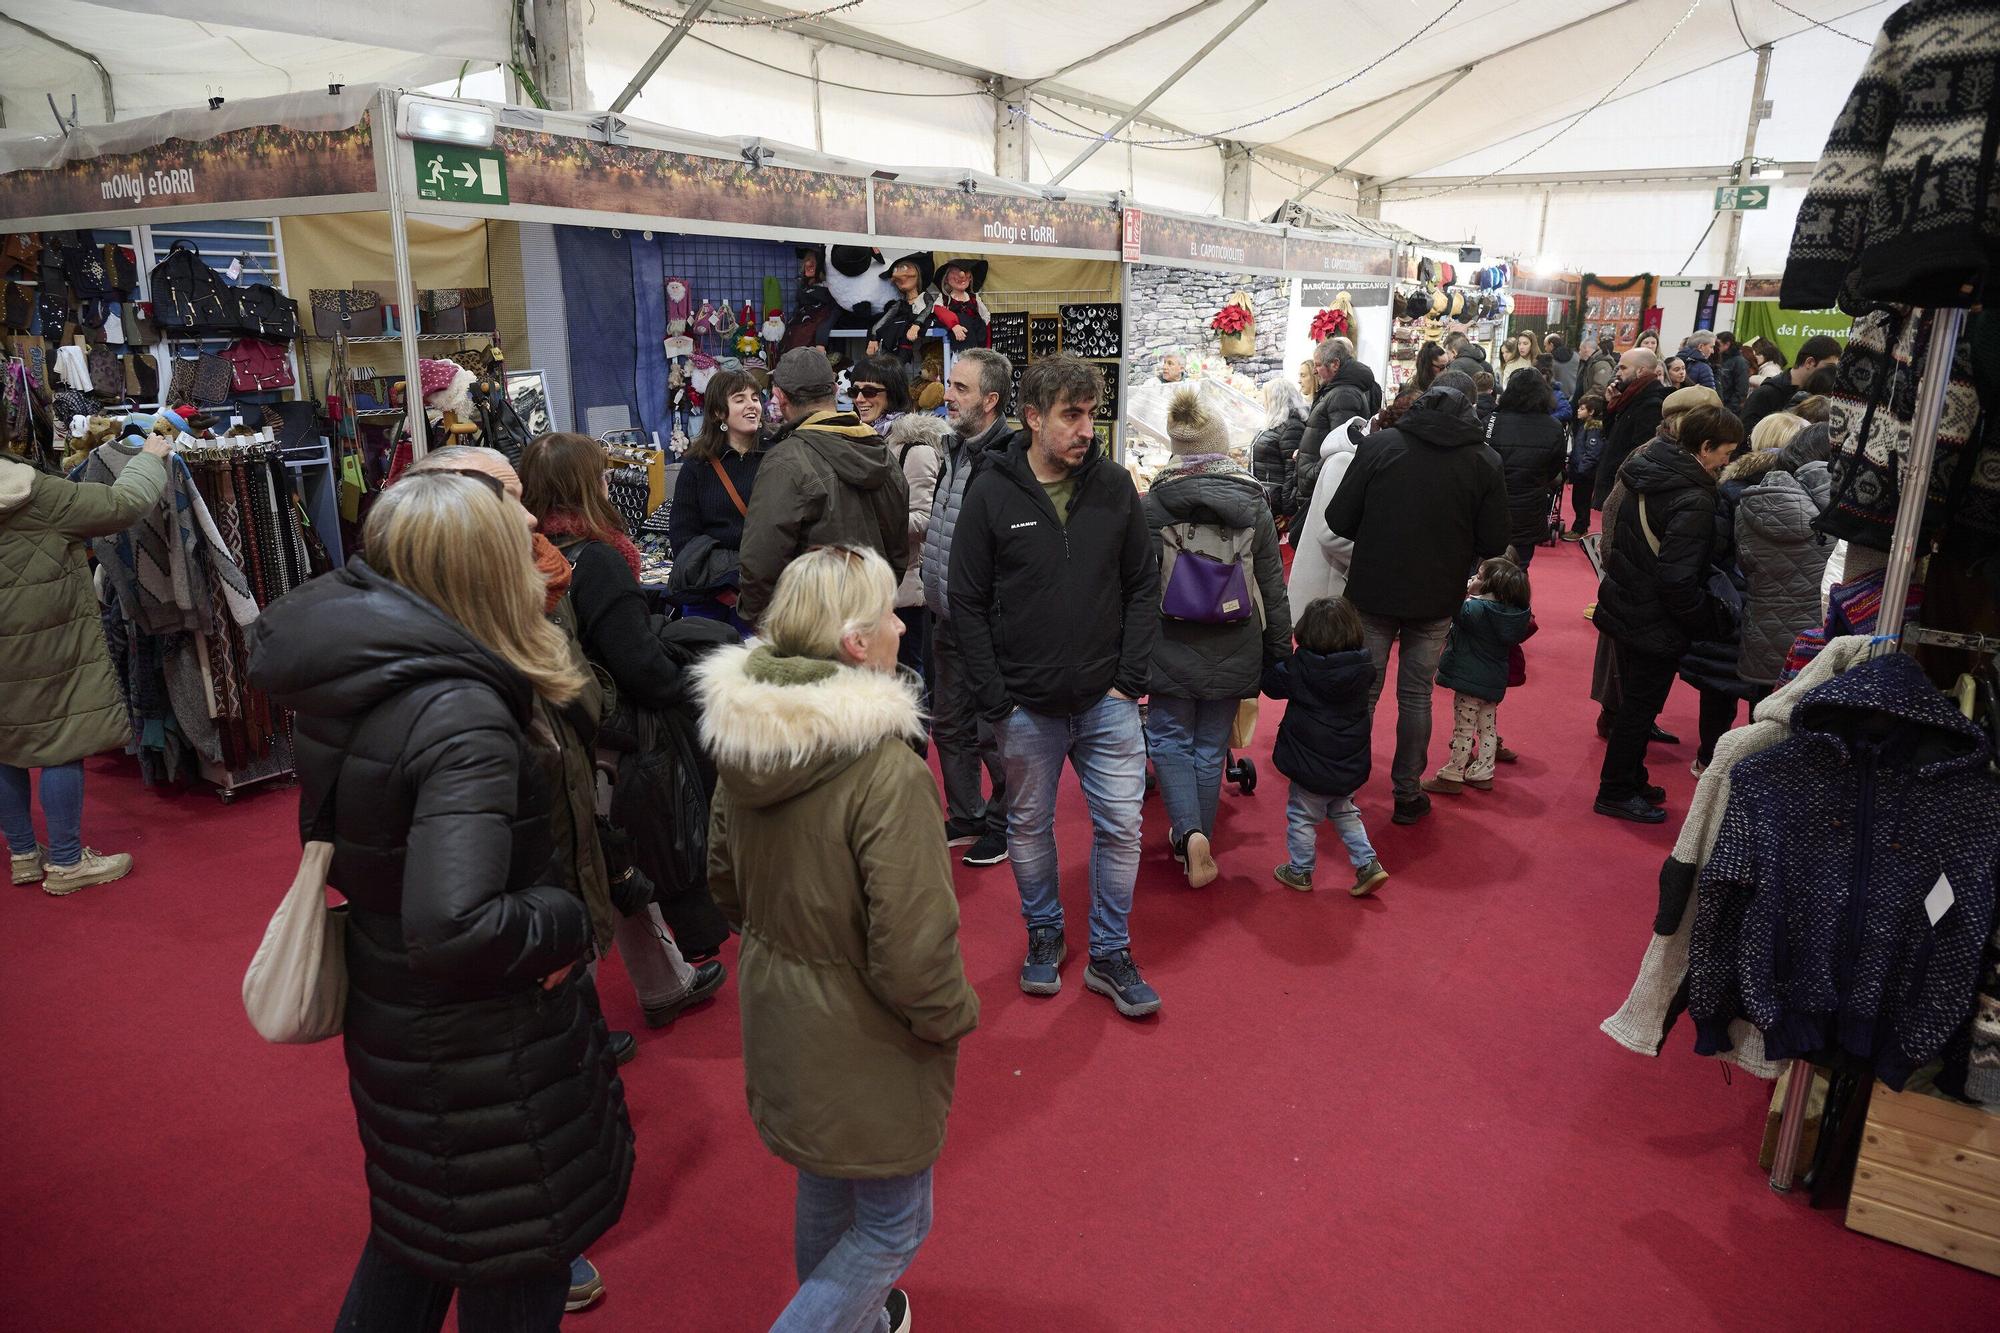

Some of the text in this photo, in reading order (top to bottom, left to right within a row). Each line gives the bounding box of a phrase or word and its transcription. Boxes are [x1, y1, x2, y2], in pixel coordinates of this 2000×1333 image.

[984, 221, 1058, 243] mOngi e ToRRI.
[1190, 242, 1198, 256] EL
[1776, 324, 1797, 336] del
[1010, 521, 1037, 529] MAMMUT
